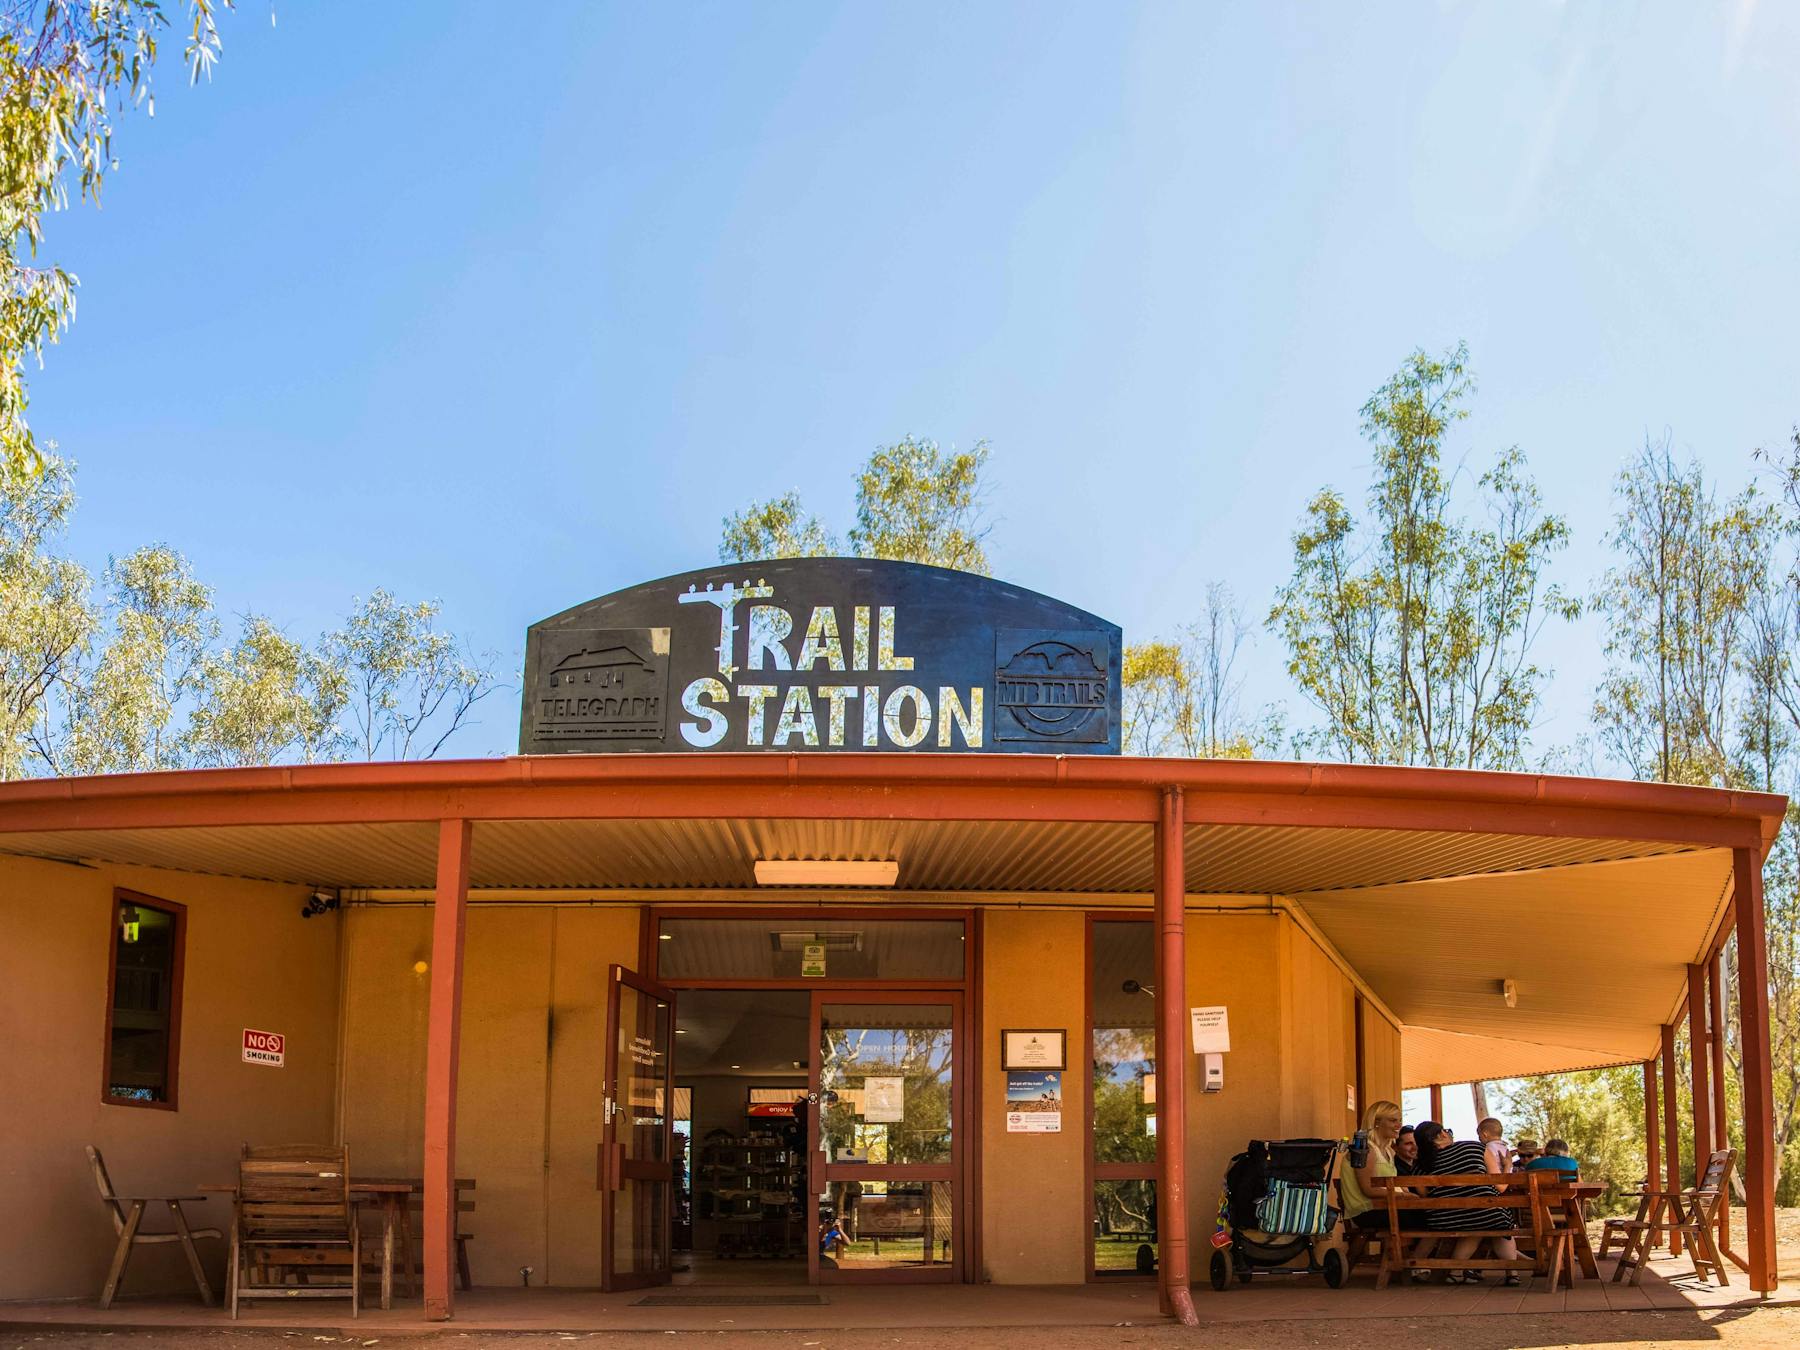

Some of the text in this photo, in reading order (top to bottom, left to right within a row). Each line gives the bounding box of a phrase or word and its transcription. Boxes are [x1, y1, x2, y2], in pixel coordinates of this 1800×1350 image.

[679, 577, 915, 683] TRAIL
[998, 681, 1105, 705] MTB TRAILS
[541, 697, 660, 717] TELEGRAPH
[679, 677, 984, 748] STATION
[248, 1034, 266, 1048] NO
[246, 1051, 281, 1062] SMOKING
